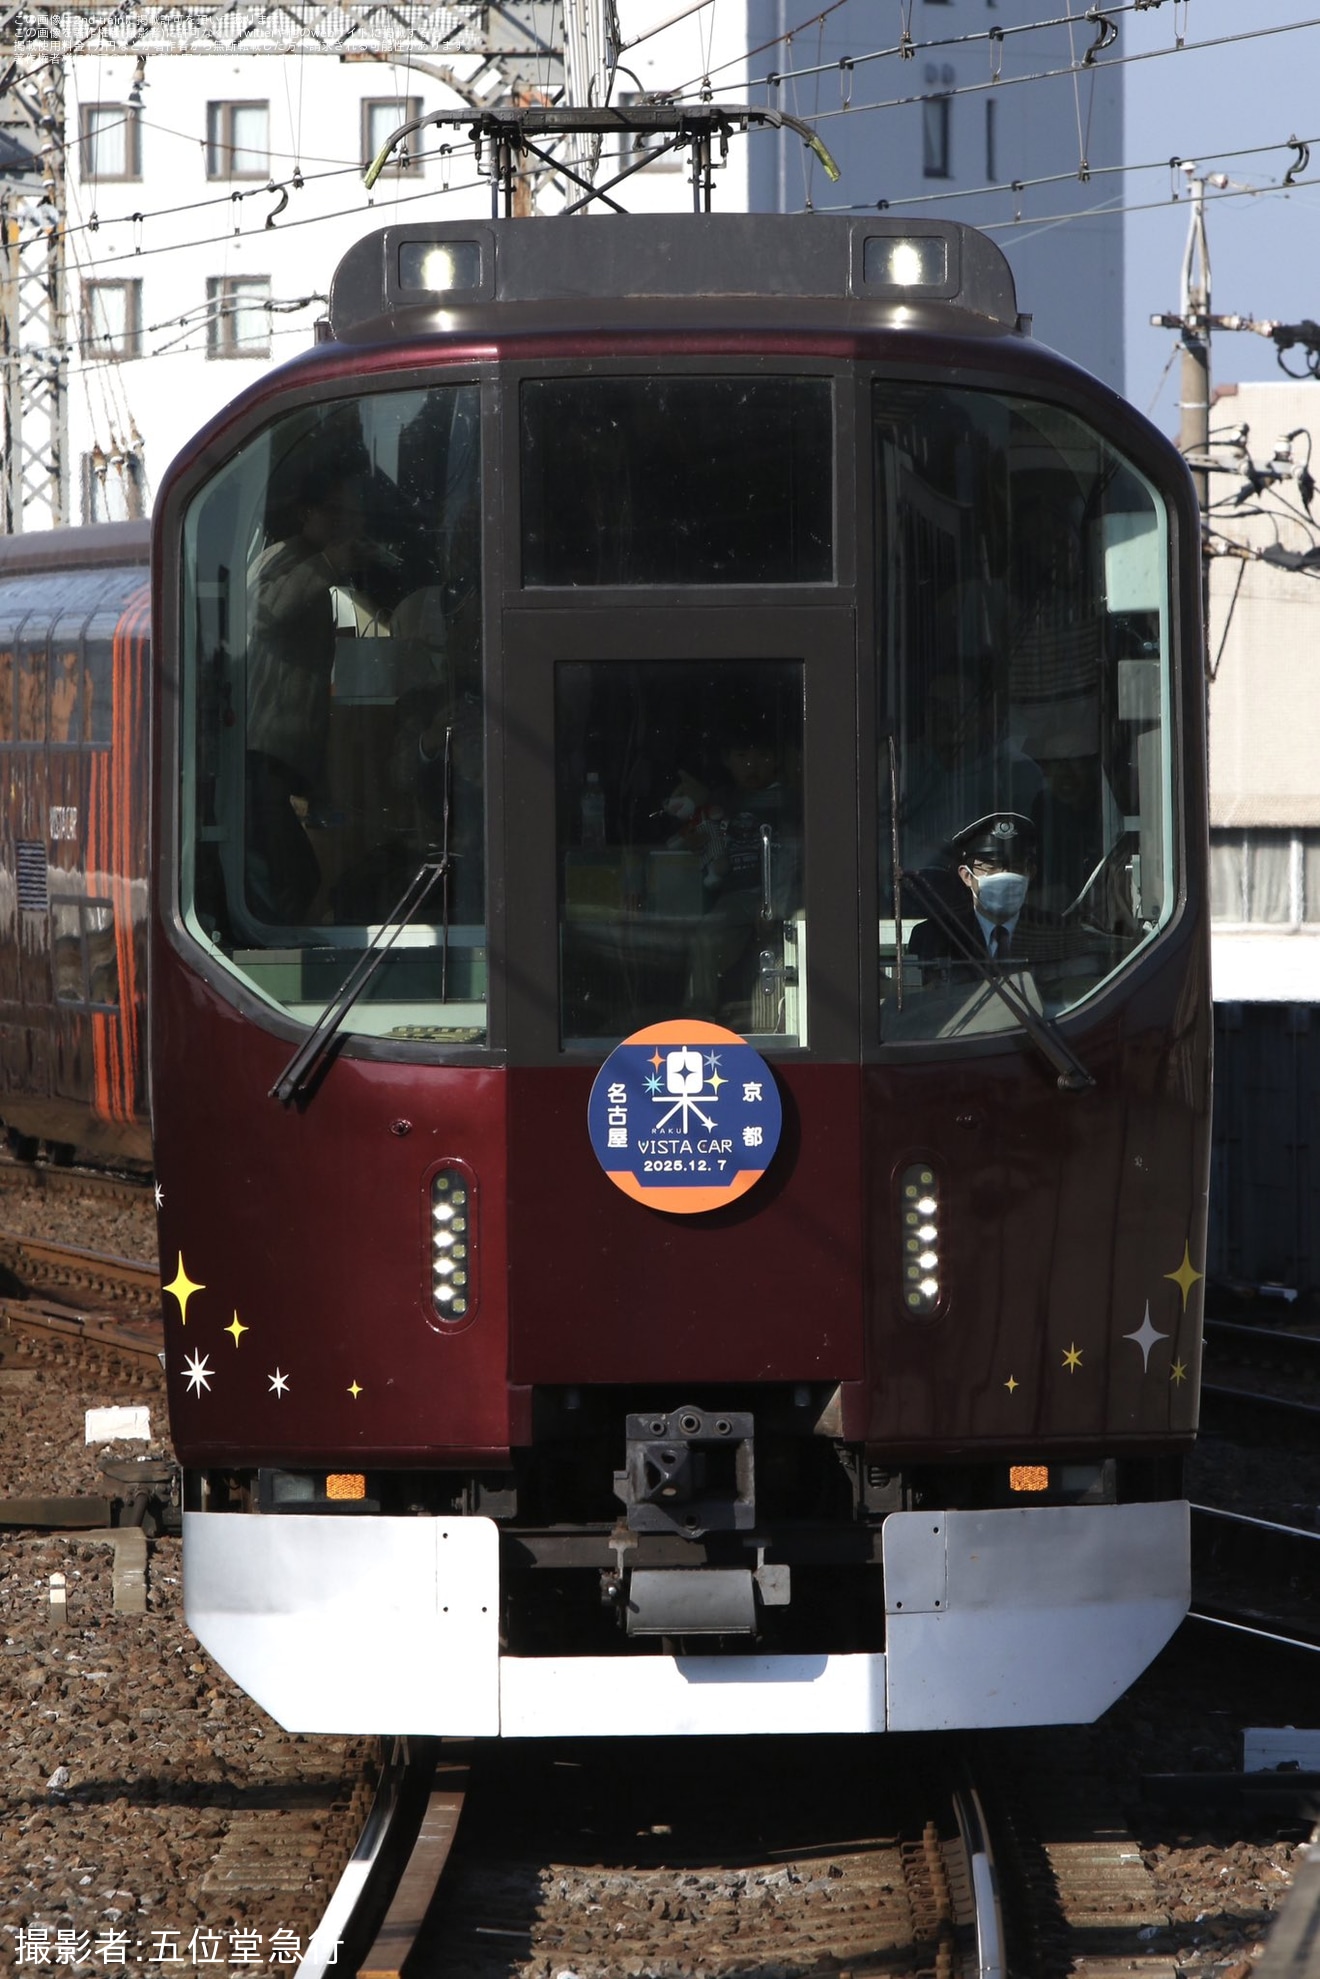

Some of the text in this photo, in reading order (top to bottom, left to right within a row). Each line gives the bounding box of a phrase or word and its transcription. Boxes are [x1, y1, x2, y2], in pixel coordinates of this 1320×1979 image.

[607, 1082, 628, 1148] 名古屋
[651, 1127, 682, 1135] RAKU
[637, 1139, 733, 1155] VISTA CAR
